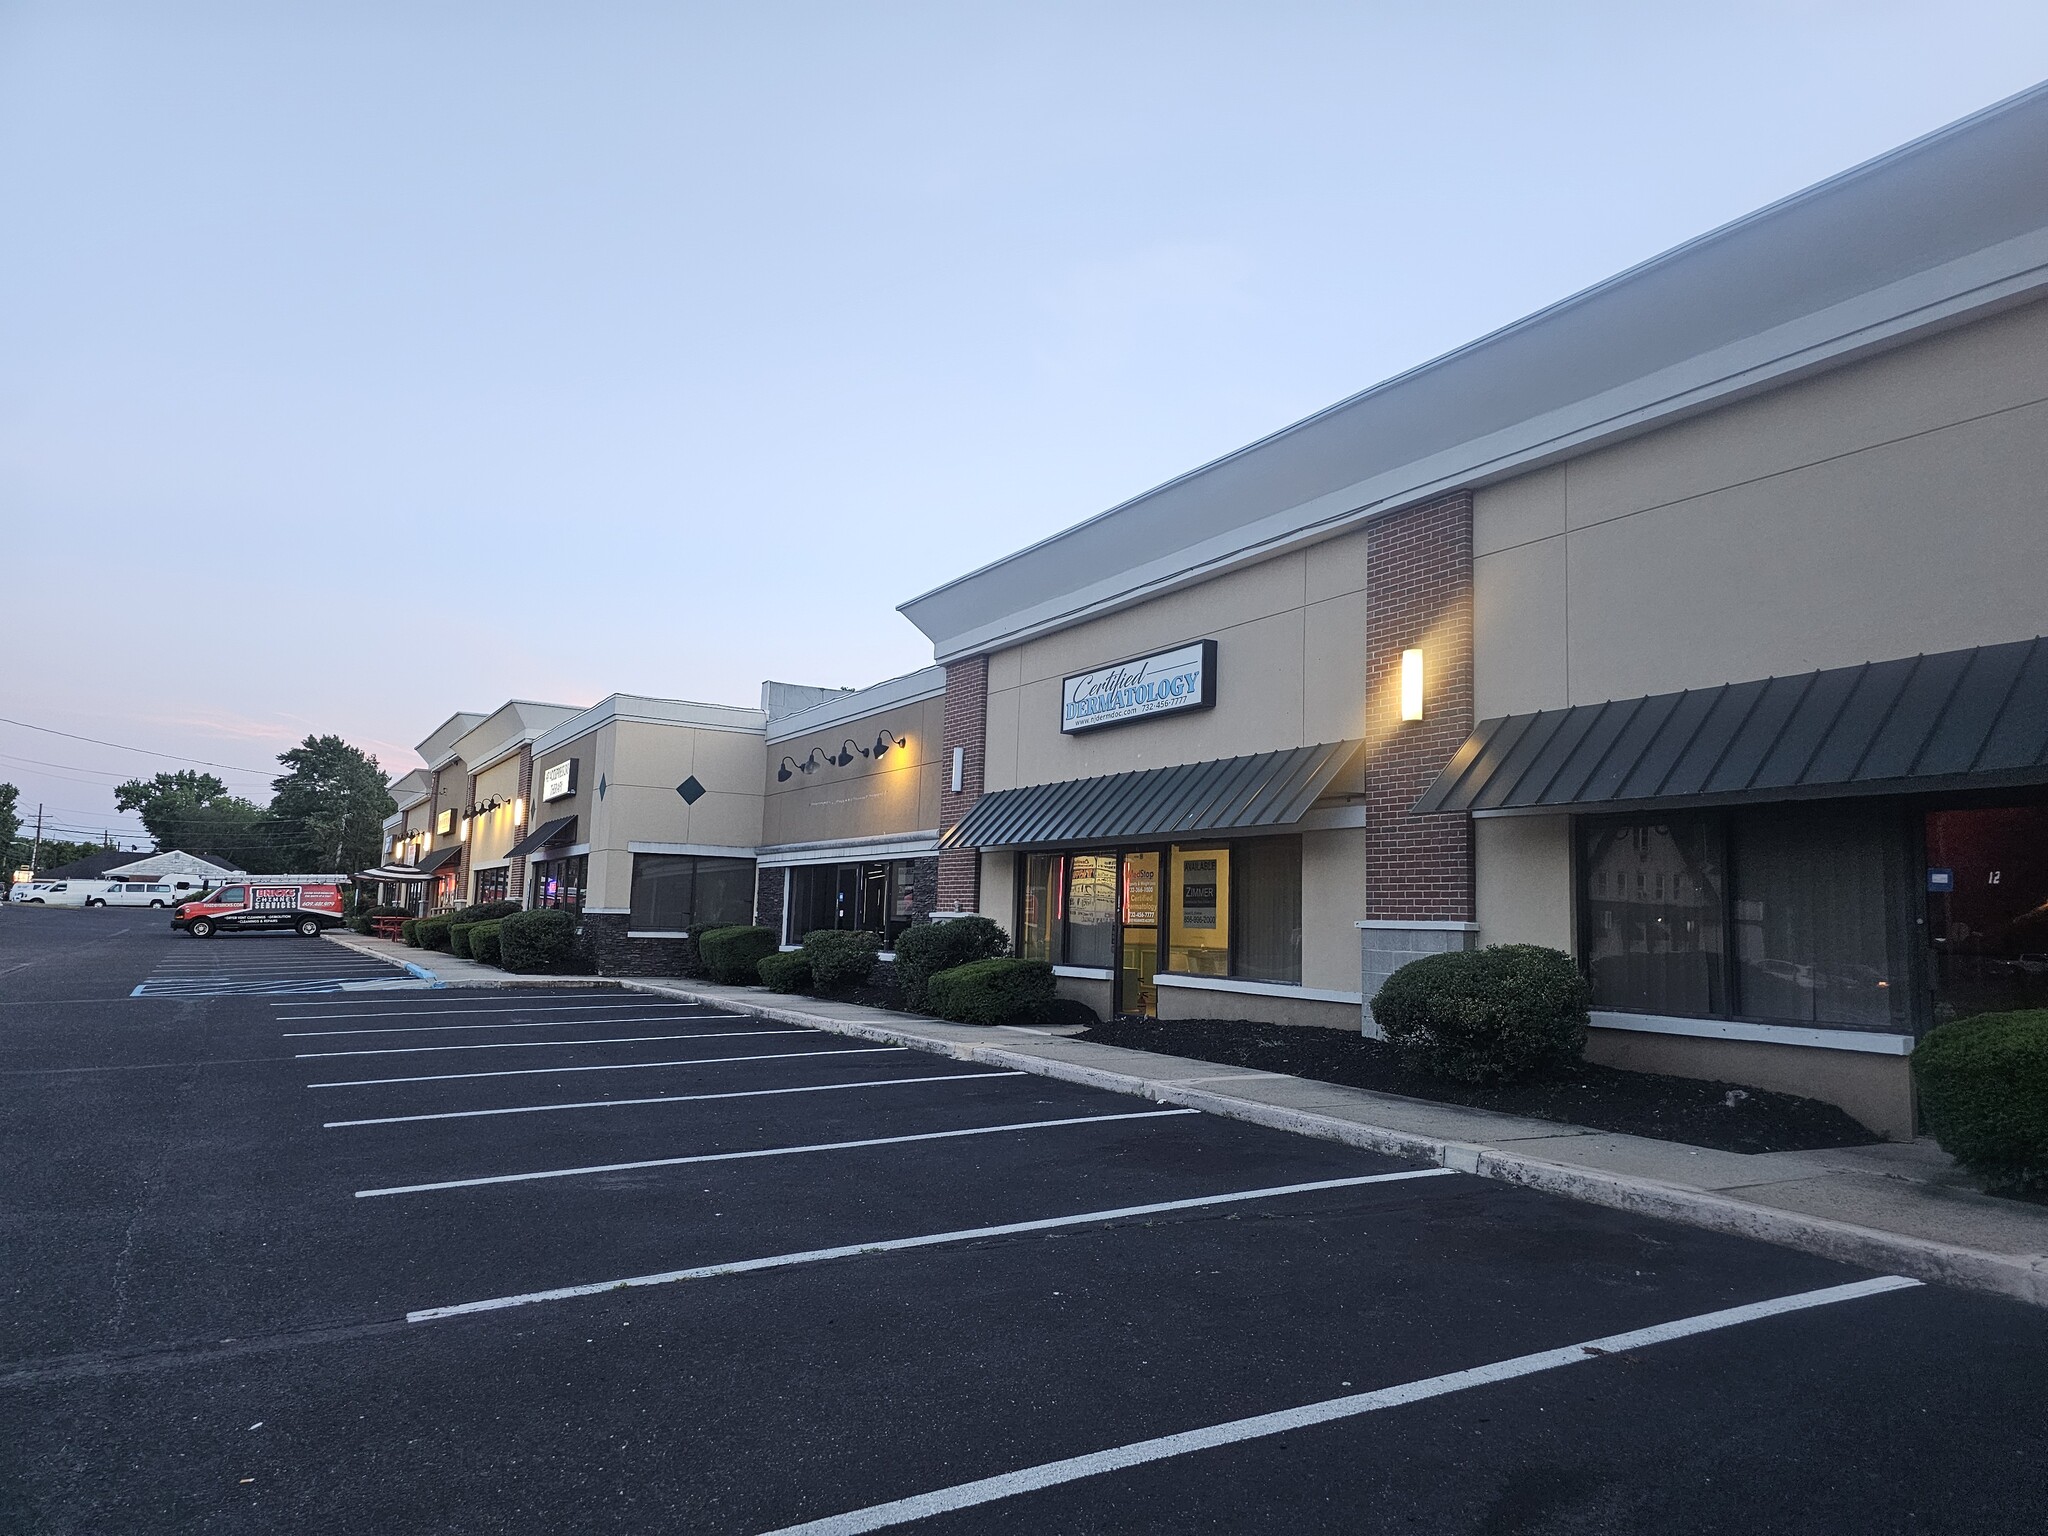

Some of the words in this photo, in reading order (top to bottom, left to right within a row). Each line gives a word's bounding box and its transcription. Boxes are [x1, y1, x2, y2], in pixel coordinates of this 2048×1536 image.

[1073, 661, 1149, 703] Certified
[1065, 671, 1199, 720] DERMATOLOGY
[1075, 708, 1137, 726] www.njdermdoc.com
[1184, 861, 1216, 872] AVAILABLE
[1988, 871, 2001, 884] 12
[256, 889, 296, 897] BRICKS
[254, 901, 297, 909] SERVICES
[1127, 902, 1157, 911] ermatology
